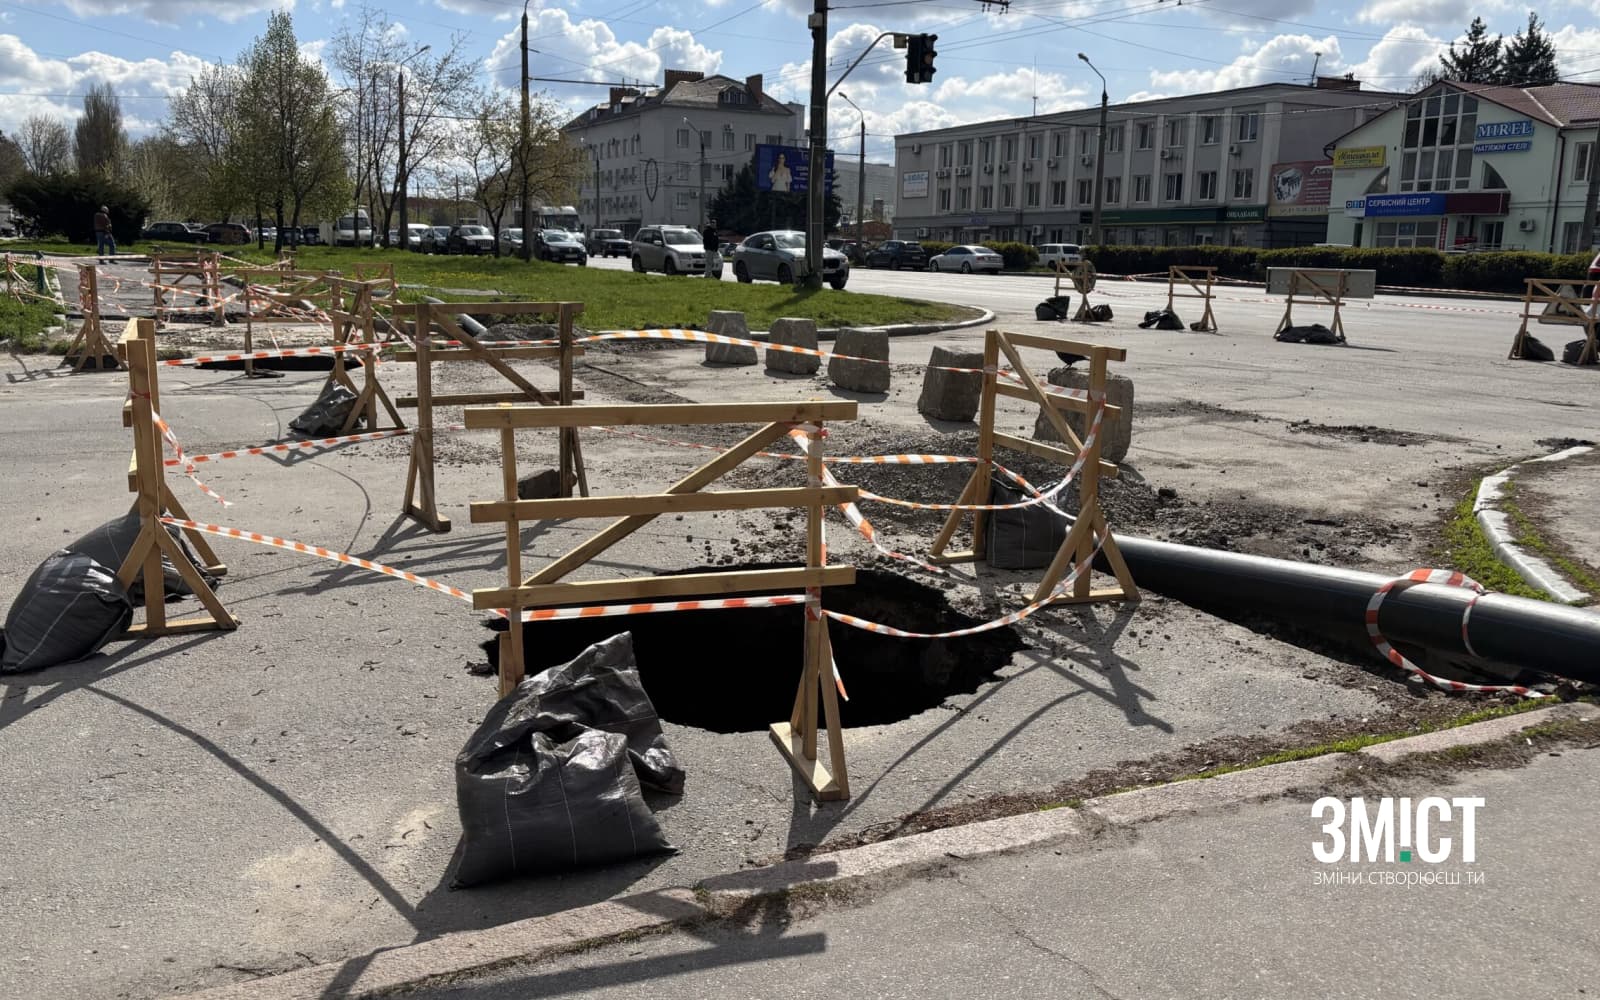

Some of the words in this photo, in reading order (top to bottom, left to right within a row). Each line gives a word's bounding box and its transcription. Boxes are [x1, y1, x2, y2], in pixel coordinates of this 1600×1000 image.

[1478, 122, 1531, 137] MIREL
[1368, 198, 1406, 207] СЕРВІСНИЙ
[1407, 197, 1431, 206] ЦЕНТР
